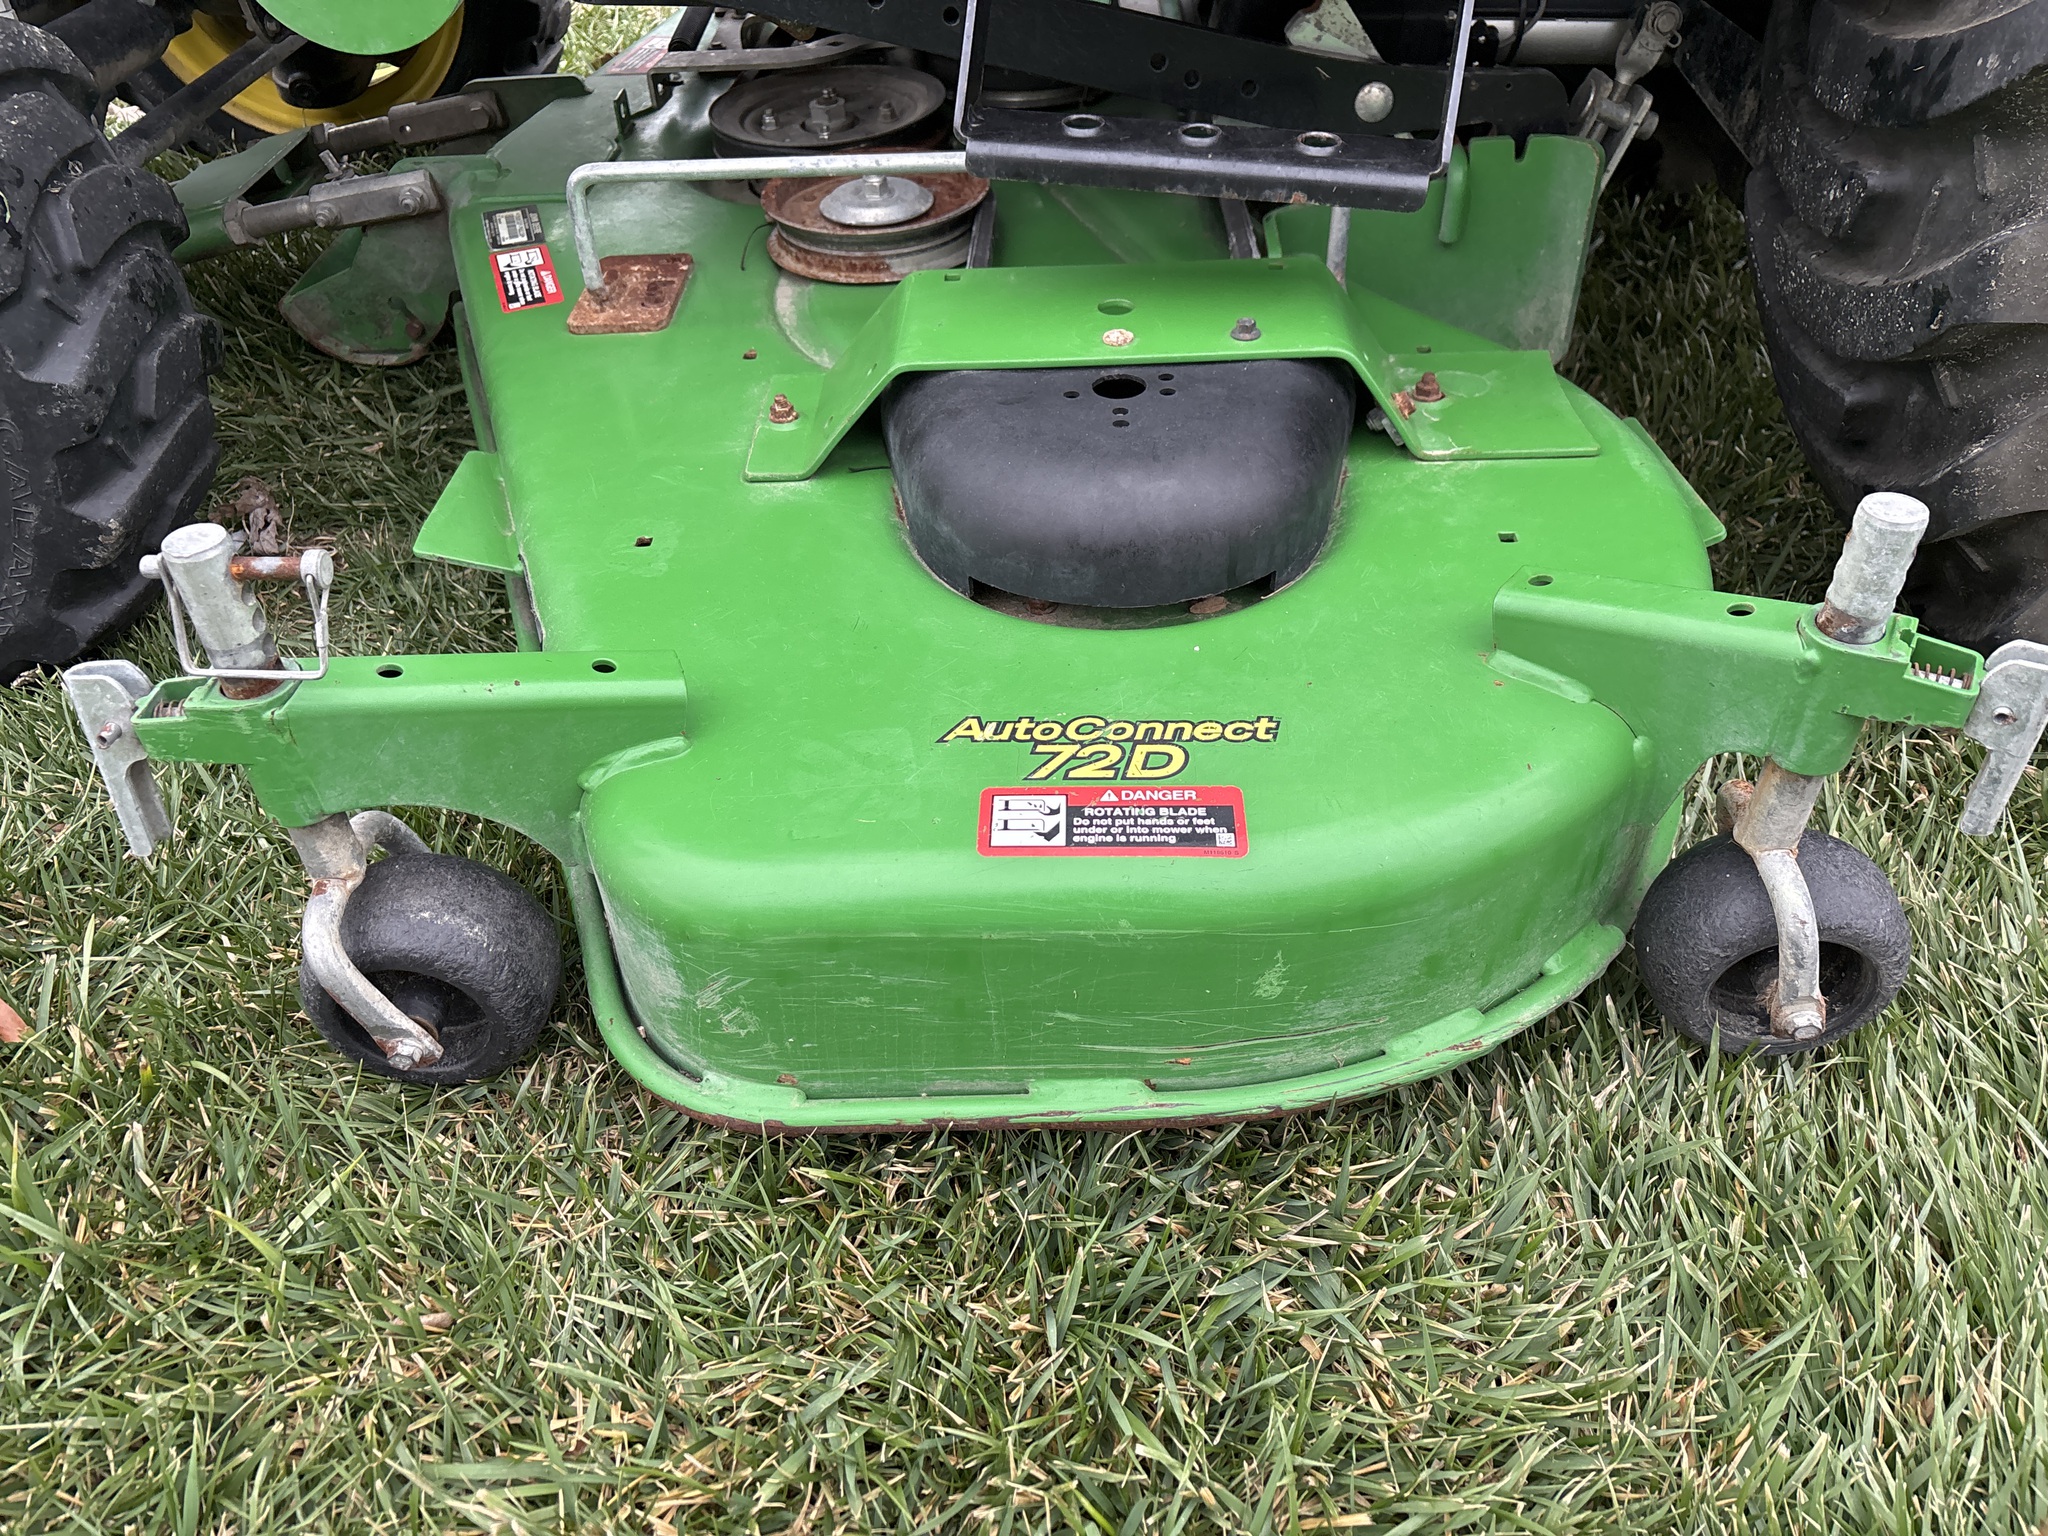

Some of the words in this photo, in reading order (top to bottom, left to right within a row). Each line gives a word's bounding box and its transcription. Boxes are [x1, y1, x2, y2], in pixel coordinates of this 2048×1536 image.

[935, 715, 1280, 743] AutoConnect
[1022, 741, 1190, 780] 72D
[1121, 790, 1197, 800] DANGER
[1084, 807, 1156, 816] ROTATING
[1159, 807, 1207, 816] BLADE
[1073, 817, 1090, 826] Do
[1092, 818, 1112, 826] not
[1115, 818, 1135, 827] put
[1137, 817, 1174, 826] hands
[1192, 817, 1216, 825] feet
[1073, 826, 1108, 834] under
[1126, 826, 1150, 834] into
[1195, 826, 1228, 834] when
[1072, 834, 1114, 844] engine
[1116, 834, 1127, 842] is
[1129, 834, 1177, 844] running
